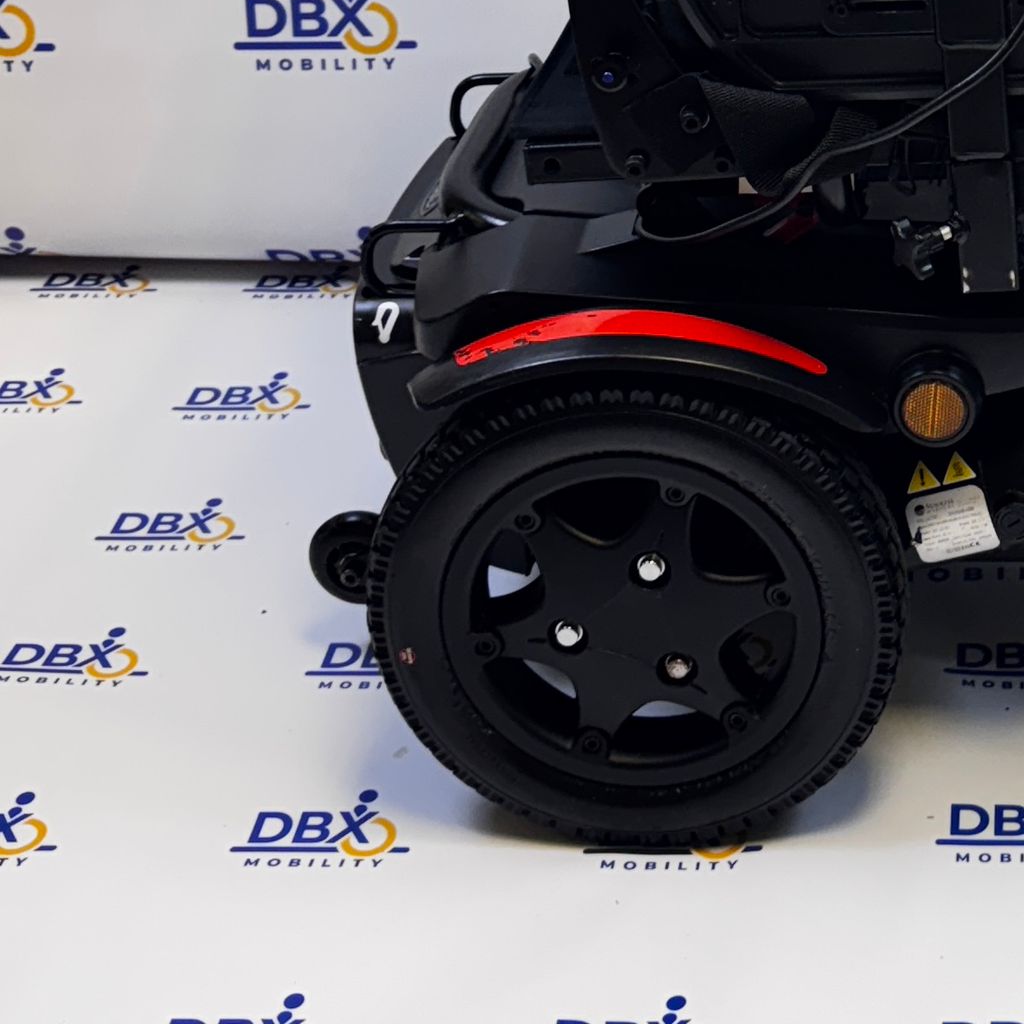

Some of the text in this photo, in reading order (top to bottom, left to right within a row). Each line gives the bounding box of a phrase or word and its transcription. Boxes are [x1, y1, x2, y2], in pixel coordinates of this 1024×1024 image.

[255, 58, 397, 72] MOBILITY
[43, 272, 130, 288] DBX
[255, 275, 342, 288] DBX
[0, 380, 64, 399] BX
[185, 384, 287, 406] DBX
[109, 512, 223, 534] DBX
[105, 544, 223, 552] MOBILITY
[2, 643, 125, 669] DBX
[246, 811, 380, 844] DBX
[242, 858, 384, 868] MOBILITY
[599, 859, 739, 871] MOBILITY
